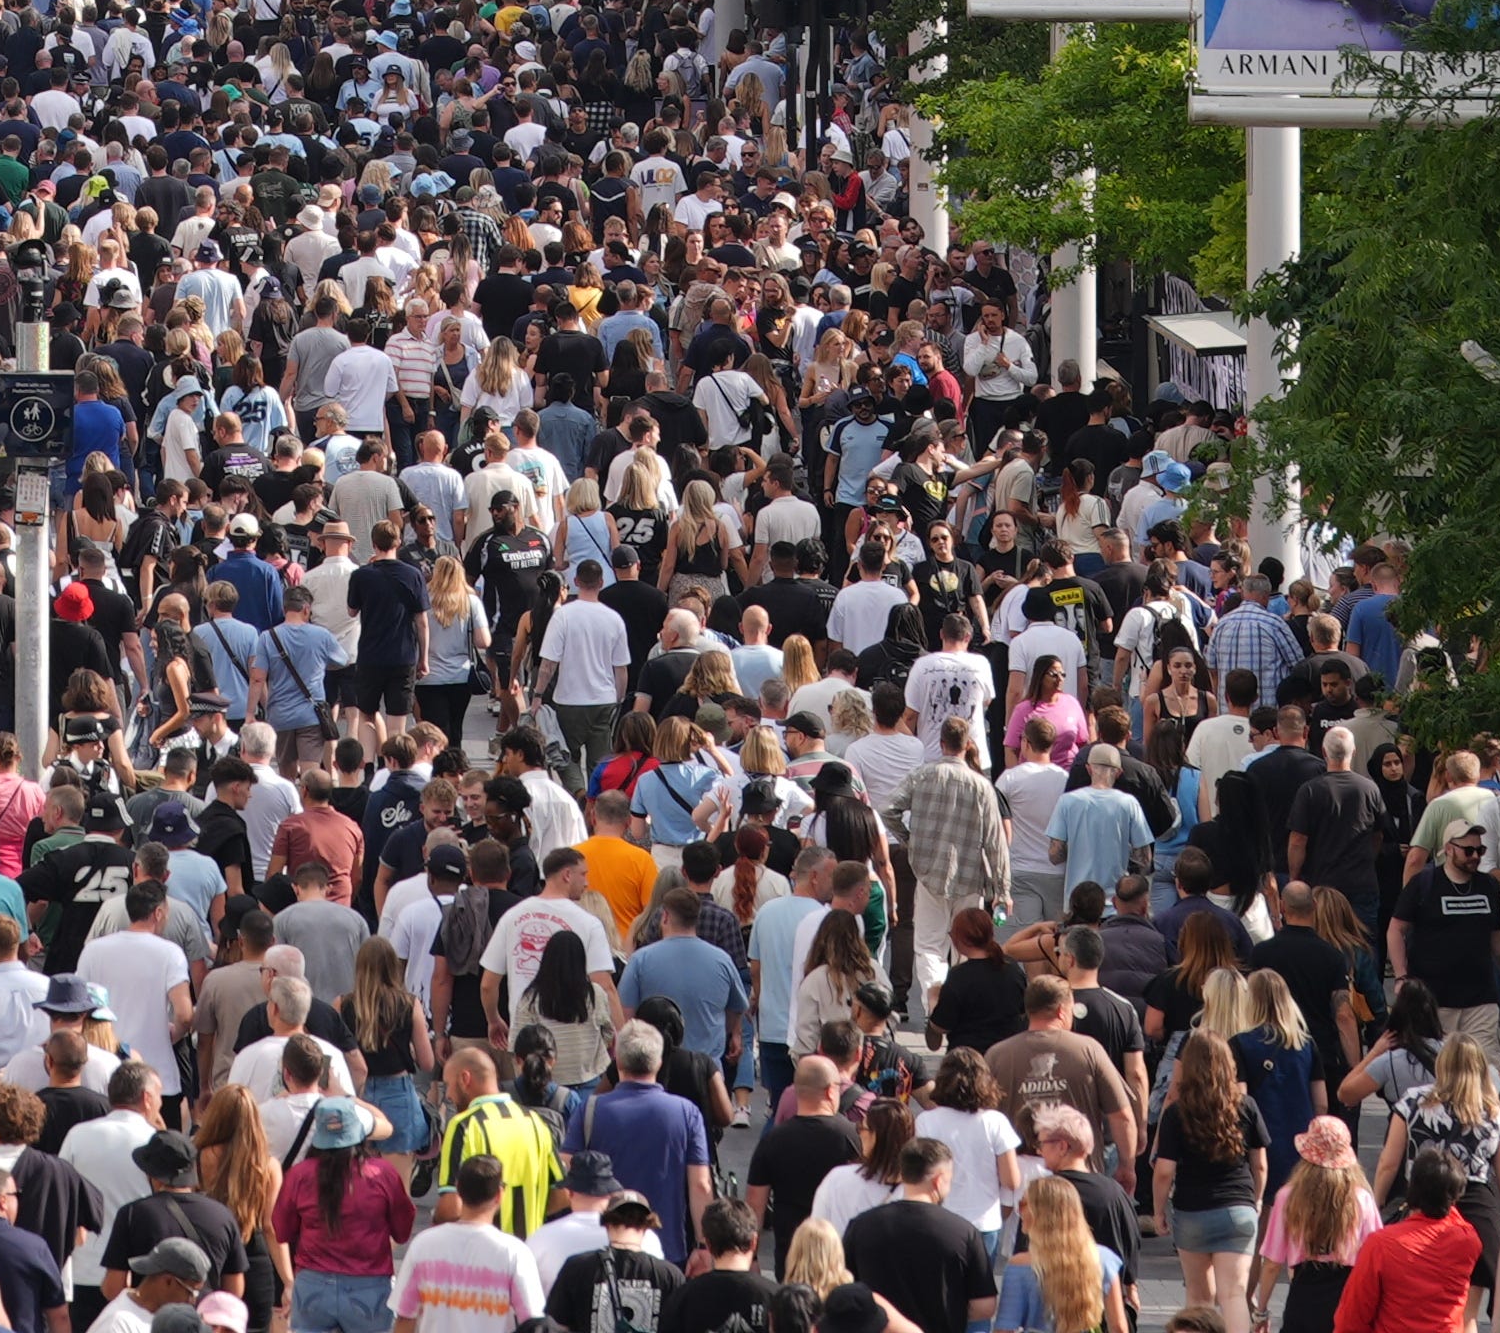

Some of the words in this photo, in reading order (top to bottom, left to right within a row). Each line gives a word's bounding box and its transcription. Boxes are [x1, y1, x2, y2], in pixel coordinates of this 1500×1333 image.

[1218, 53, 1327, 75] ARMANI
[232, 399, 268, 423] 25
[616, 516, 656, 544] 25
[502, 550, 543, 563] Emirates
[1018, 1079, 1068, 1094] ADIDAS
